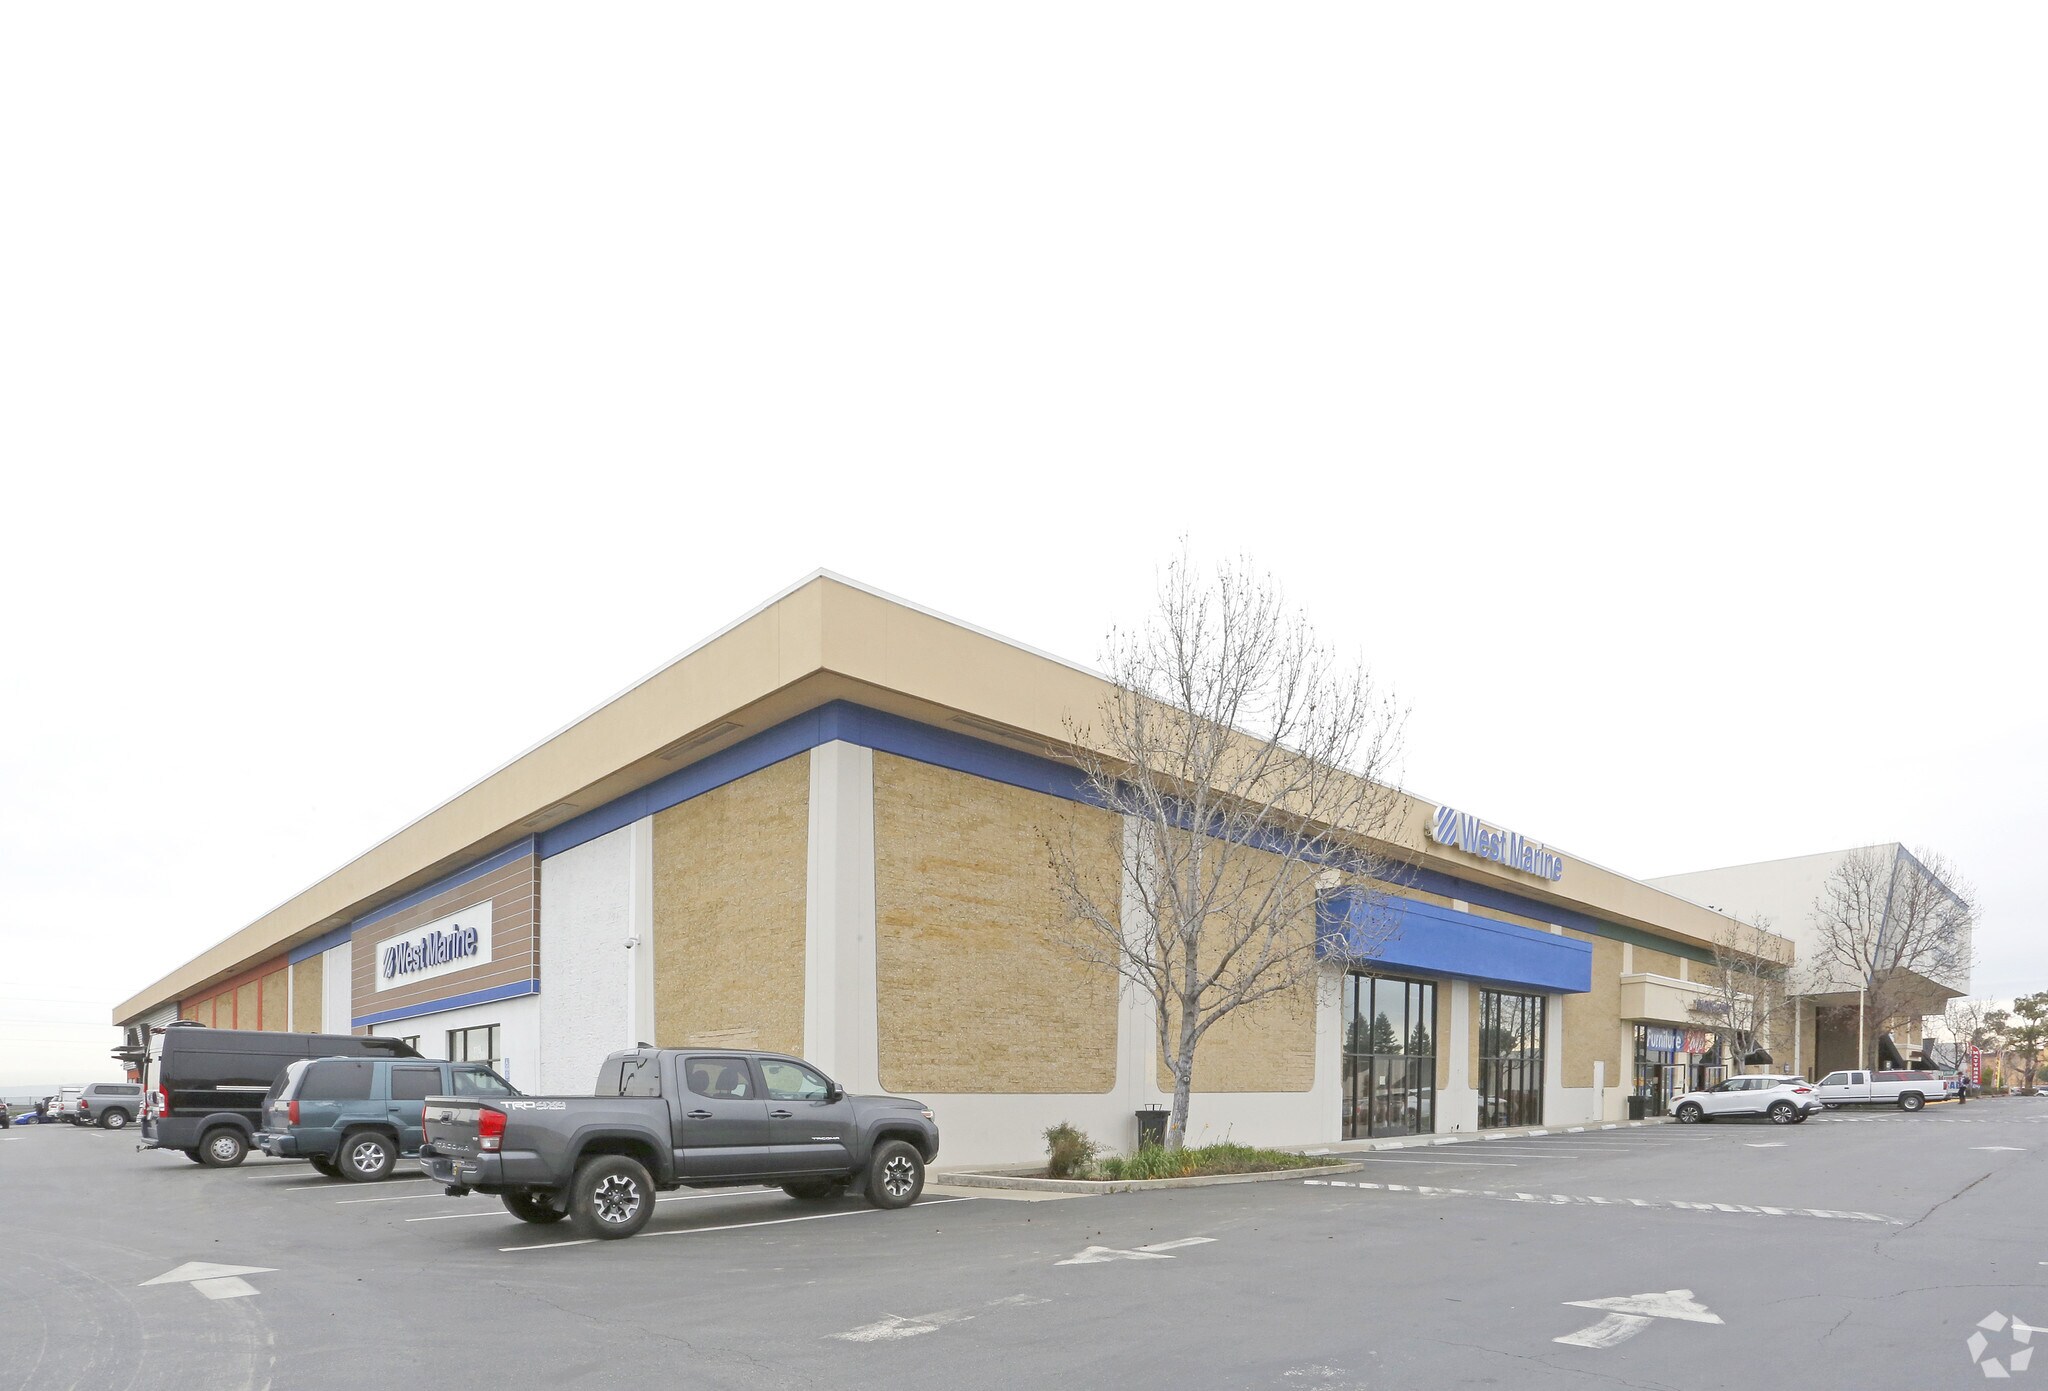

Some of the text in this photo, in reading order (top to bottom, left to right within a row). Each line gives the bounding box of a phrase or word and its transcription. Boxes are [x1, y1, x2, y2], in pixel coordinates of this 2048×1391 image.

[1456, 812, 1563, 882] West Marine
[395, 924, 478, 974] West Marine
